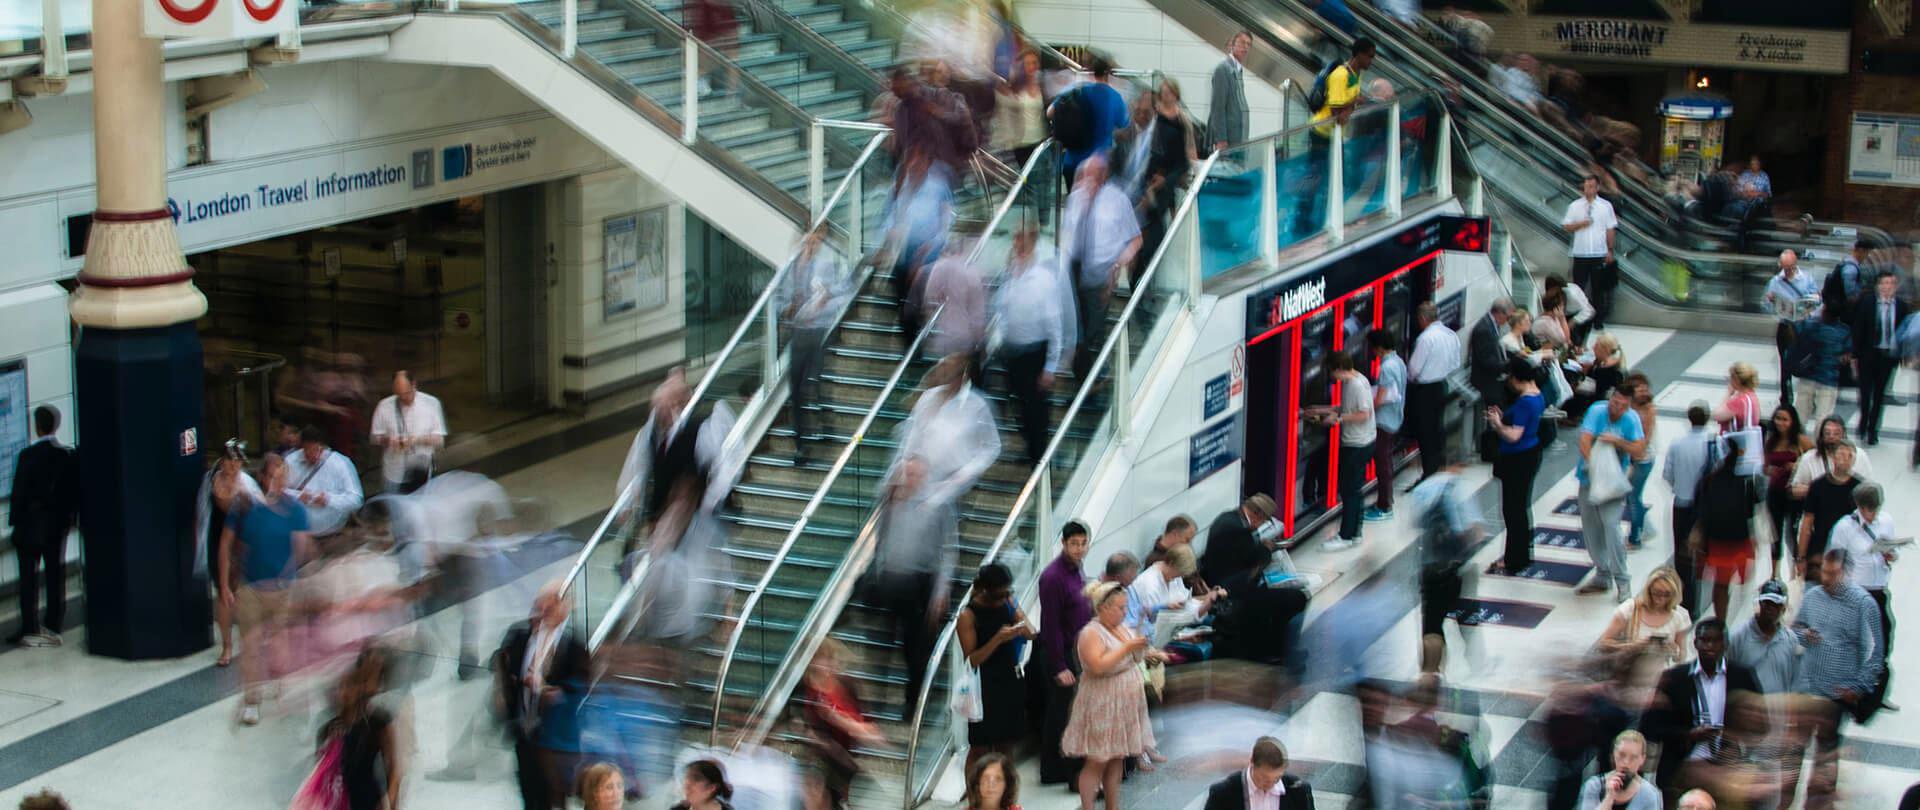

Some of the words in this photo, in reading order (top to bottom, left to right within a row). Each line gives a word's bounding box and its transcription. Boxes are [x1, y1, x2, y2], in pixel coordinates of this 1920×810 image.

[1555, 20, 1669, 45] MERCHANT
[1737, 31, 1808, 48] Freehouse
[1570, 40, 1652, 57] BISHOPSGATE
[1755, 47, 1804, 61] Kitchen
[186, 191, 251, 223] London
[258, 178, 308, 208] Travel
[316, 164, 406, 200] Information
[1283, 274, 1327, 322] NatWest
